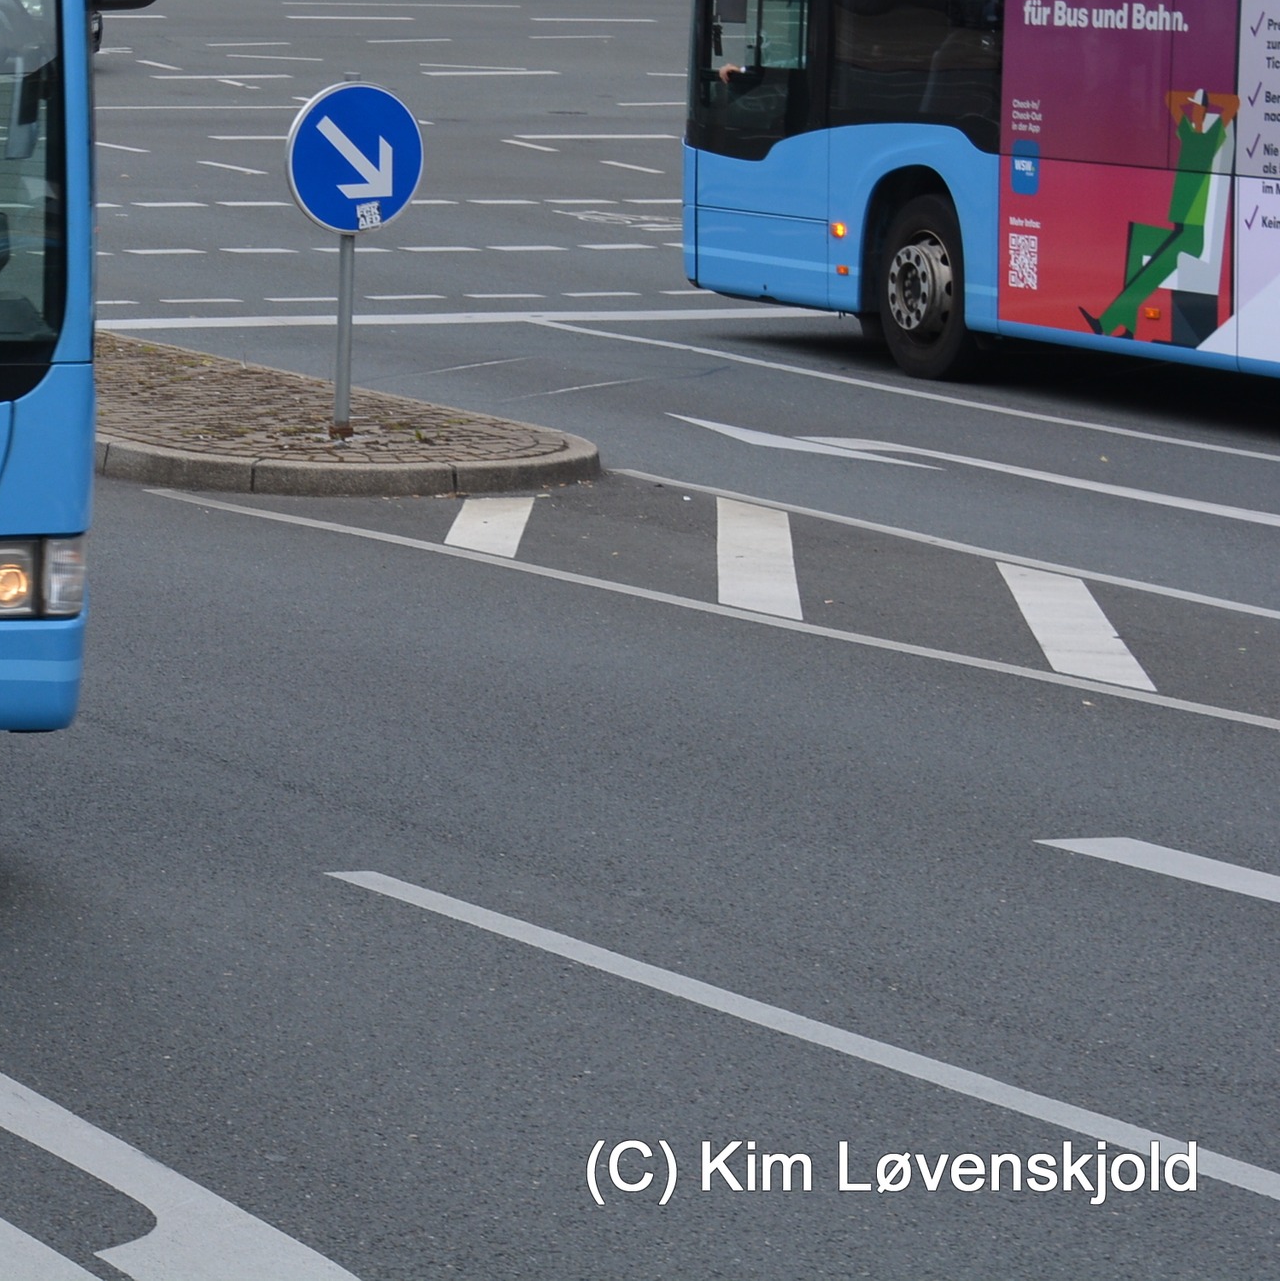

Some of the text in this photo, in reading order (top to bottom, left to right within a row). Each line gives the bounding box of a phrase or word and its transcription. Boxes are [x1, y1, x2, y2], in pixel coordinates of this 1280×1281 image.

[1023, 0, 1189, 32] für Bus und Bahn.
[1267, 18, 1280, 31] Pr
[1263, 143, 1279, 157] Nie
[1262, 162, 1278, 175] als
